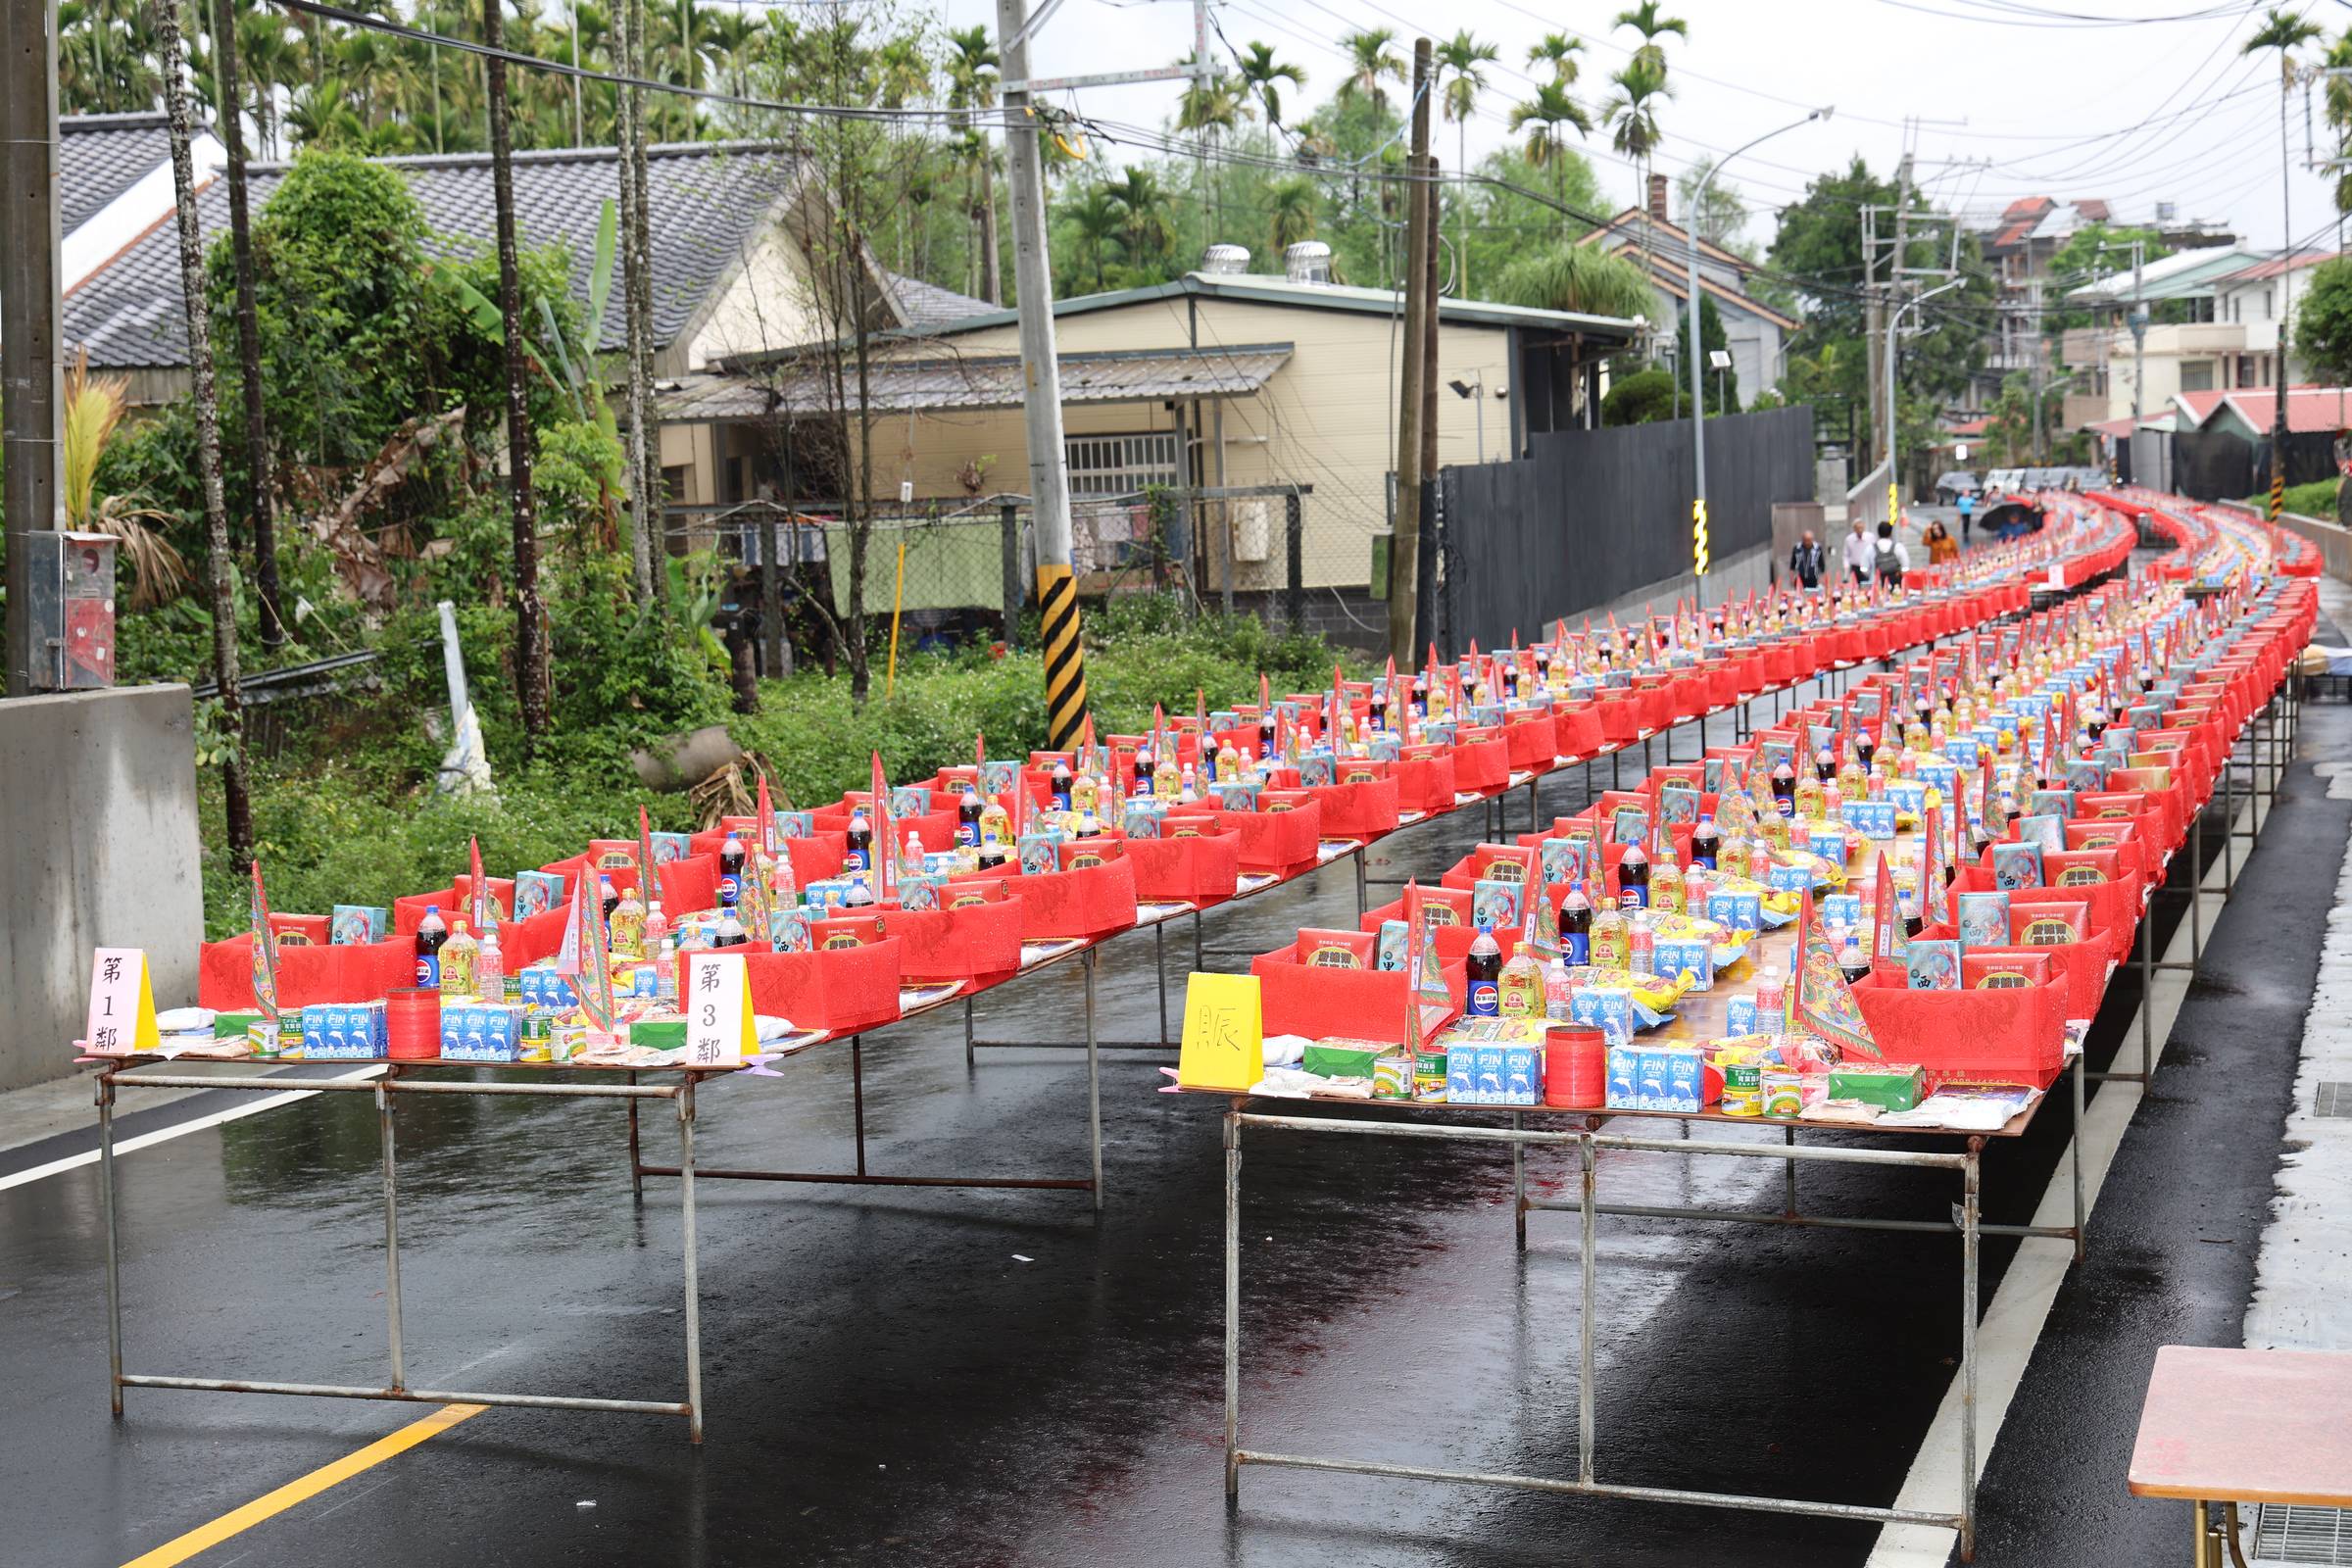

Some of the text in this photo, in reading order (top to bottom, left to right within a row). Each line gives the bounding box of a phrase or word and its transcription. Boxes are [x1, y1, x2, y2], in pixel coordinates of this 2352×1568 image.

[1738, 901, 1754, 909] FIN
[1661, 951, 1680, 960] FIN
[1685, 950, 1703, 959] FIN
[524, 976, 539, 985] FIN
[545, 976, 561, 985] FIN
[636, 976, 653, 985] FIN
[94, 957, 122, 1052] 第1鄰
[1578, 1000, 1596, 1009] FIN
[1603, 1000, 1623, 1010] FIN
[697, 963, 720, 1064] 第3鄰
[1732, 1006, 1752, 1016] FIN
[306, 1014, 322, 1024] FIN
[328, 1014, 346, 1024] FIN
[350, 1013, 368, 1023] FIN
[444, 1015, 462, 1024] FIN
[466, 1015, 485, 1025] FIN
[490, 1016, 509, 1026] FIN
[1450, 1054, 1474, 1064] FIN
[1478, 1054, 1501, 1065] FIN
[1507, 1054, 1532, 1066] FIN
[1612, 1055, 1636, 1070] FIN
[1642, 1059, 1666, 1071] FIN
[1672, 1058, 1695, 1073] FIN
